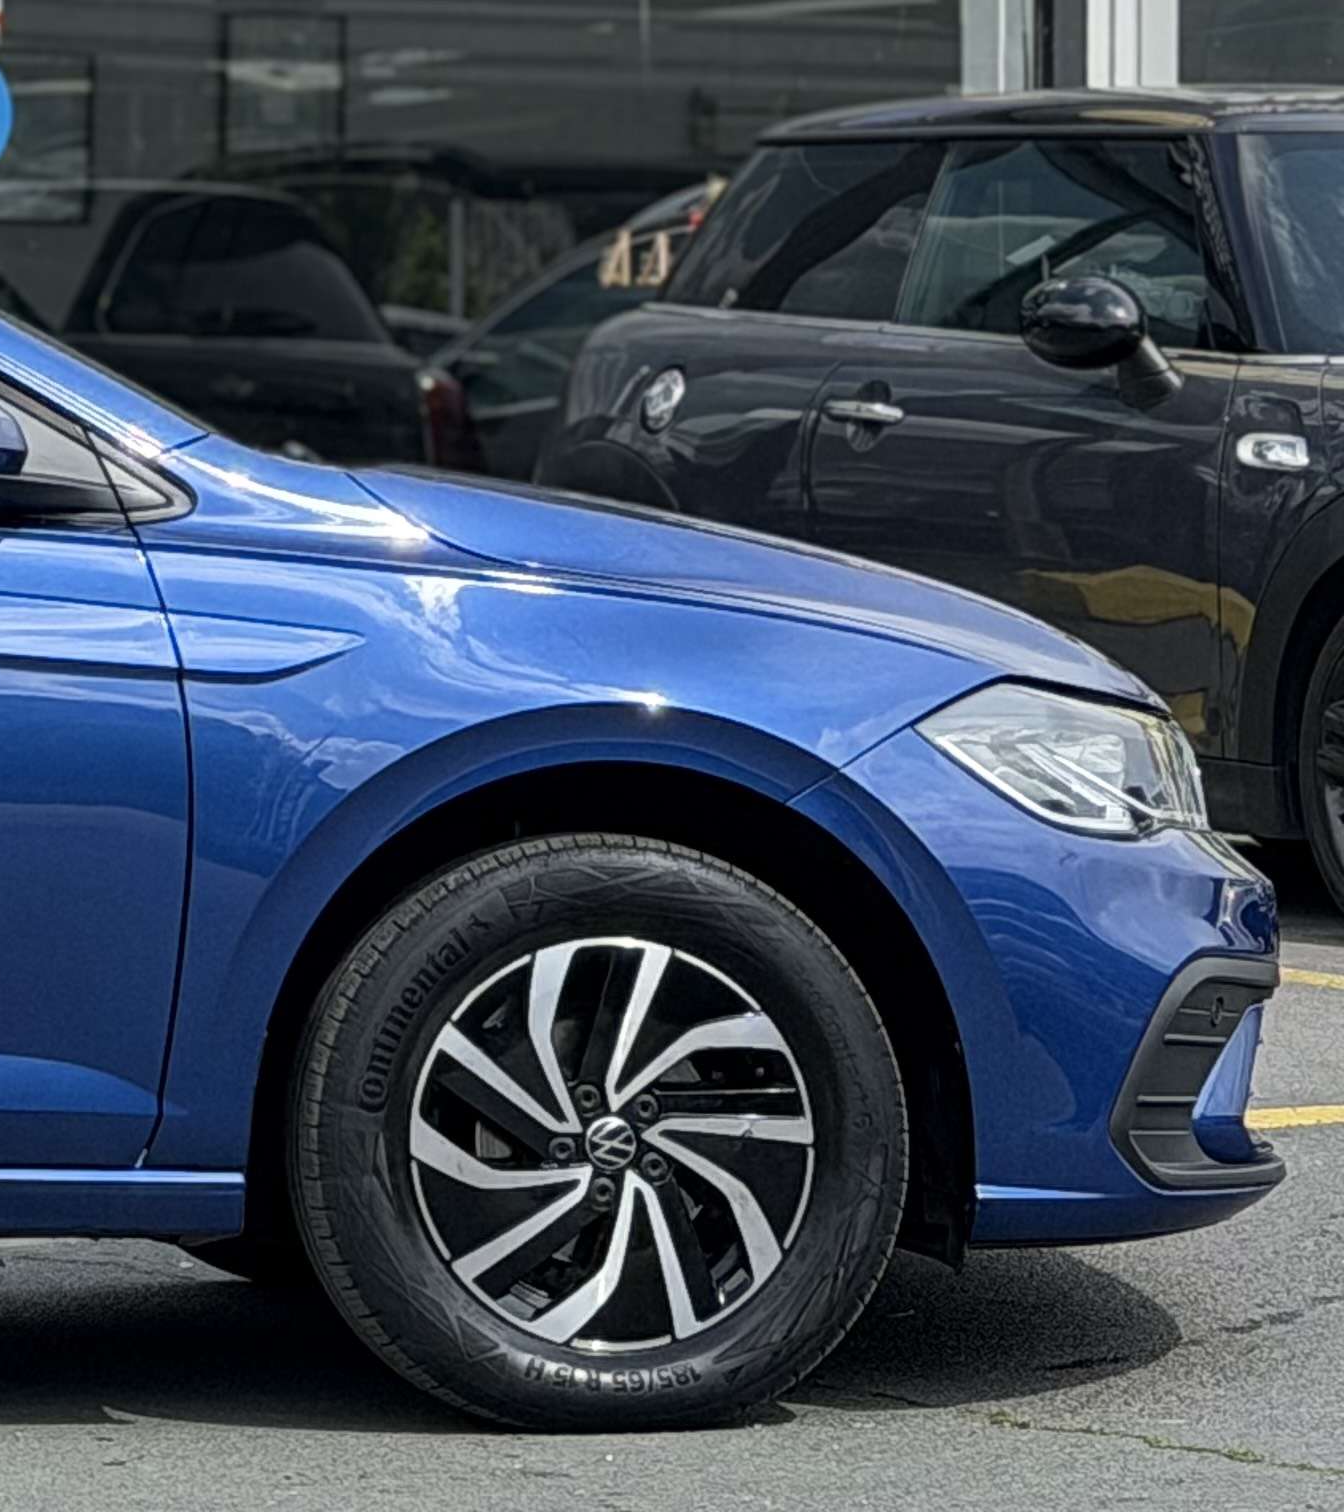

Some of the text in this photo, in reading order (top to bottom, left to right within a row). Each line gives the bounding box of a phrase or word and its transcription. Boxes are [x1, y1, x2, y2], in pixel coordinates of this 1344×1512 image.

[359, 926, 471, 1114] Continental
[524, 1356, 546, 1381] H
[612, 1364, 703, 1393] 185/65
